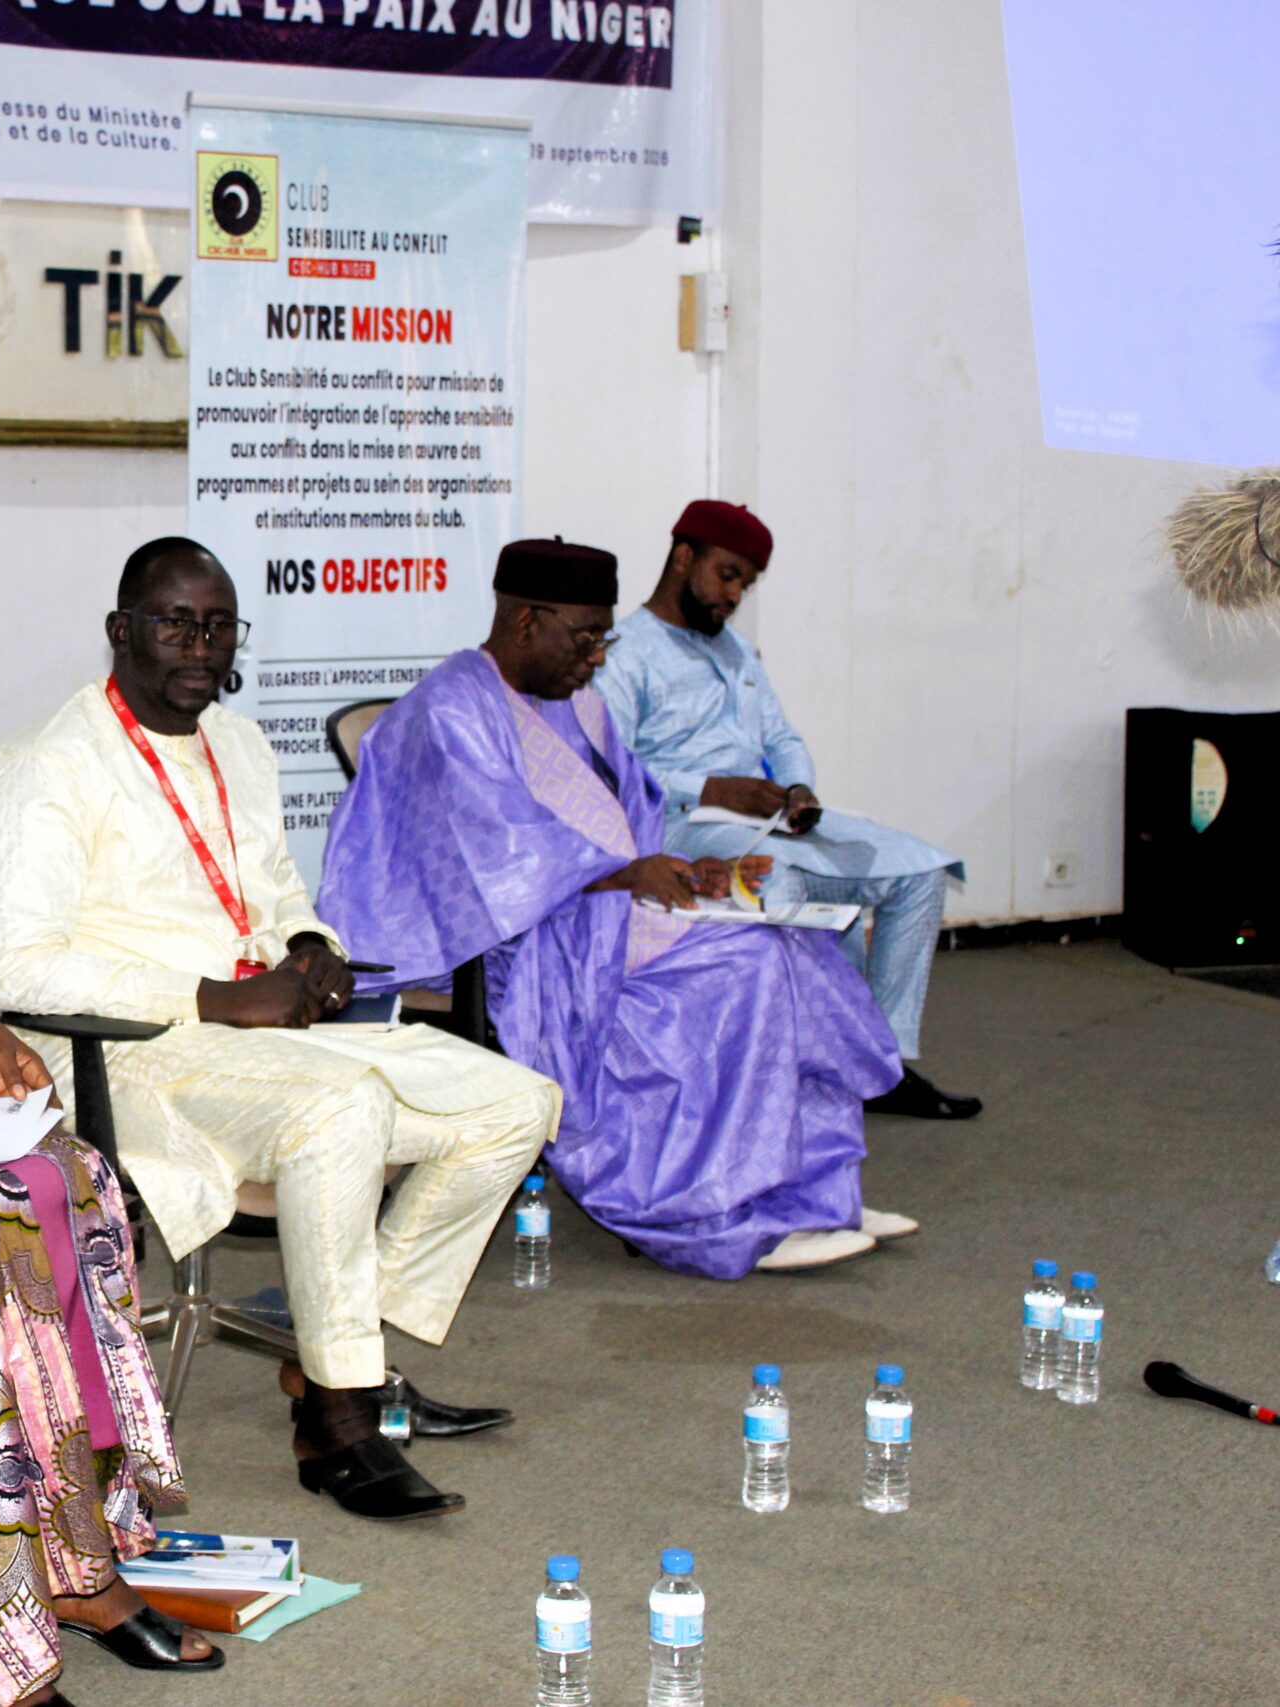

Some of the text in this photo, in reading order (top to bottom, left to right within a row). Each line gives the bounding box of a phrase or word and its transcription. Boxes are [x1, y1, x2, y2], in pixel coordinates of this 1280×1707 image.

[472, 0, 532, 38] AU
[551, 1, 670, 49] NIGER
[57, 101, 80, 121] du
[90, 106, 182, 130] Ministère
[10, 124, 28, 141] et
[37, 124, 61, 142] de
[70, 127, 88, 145] la
[97, 130, 178, 152] Culture.
[551, 147, 637, 166] septembre
[287, 183, 329, 212] CLUB
[287, 228, 448, 254] SENSIBILITE AU CONFLIT
[267, 304, 452, 344] NOTRE MISSION
[208, 368, 504, 395] Le Club Sensibilité au conflit a pour mission de
[197, 403, 277, 427] promouvoir
[363, 404, 379, 424] de
[454, 406, 514, 427] sensibilité
[231, 442, 256, 459] aux
[311, 441, 344, 459] dans
[348, 439, 360, 459] la
[363, 440, 394, 459] mise
[398, 444, 412, 459] en
[461, 443, 481, 461] des
[197, 475, 511, 499] programmes et projets au sein des organisations
[256, 508, 465, 528] et institutions membres du club.
[267, 558, 446, 594] NOS OBJECTIFS
[258, 671, 321, 688] VULGARISER
[284, 794, 303, 808] UNE
